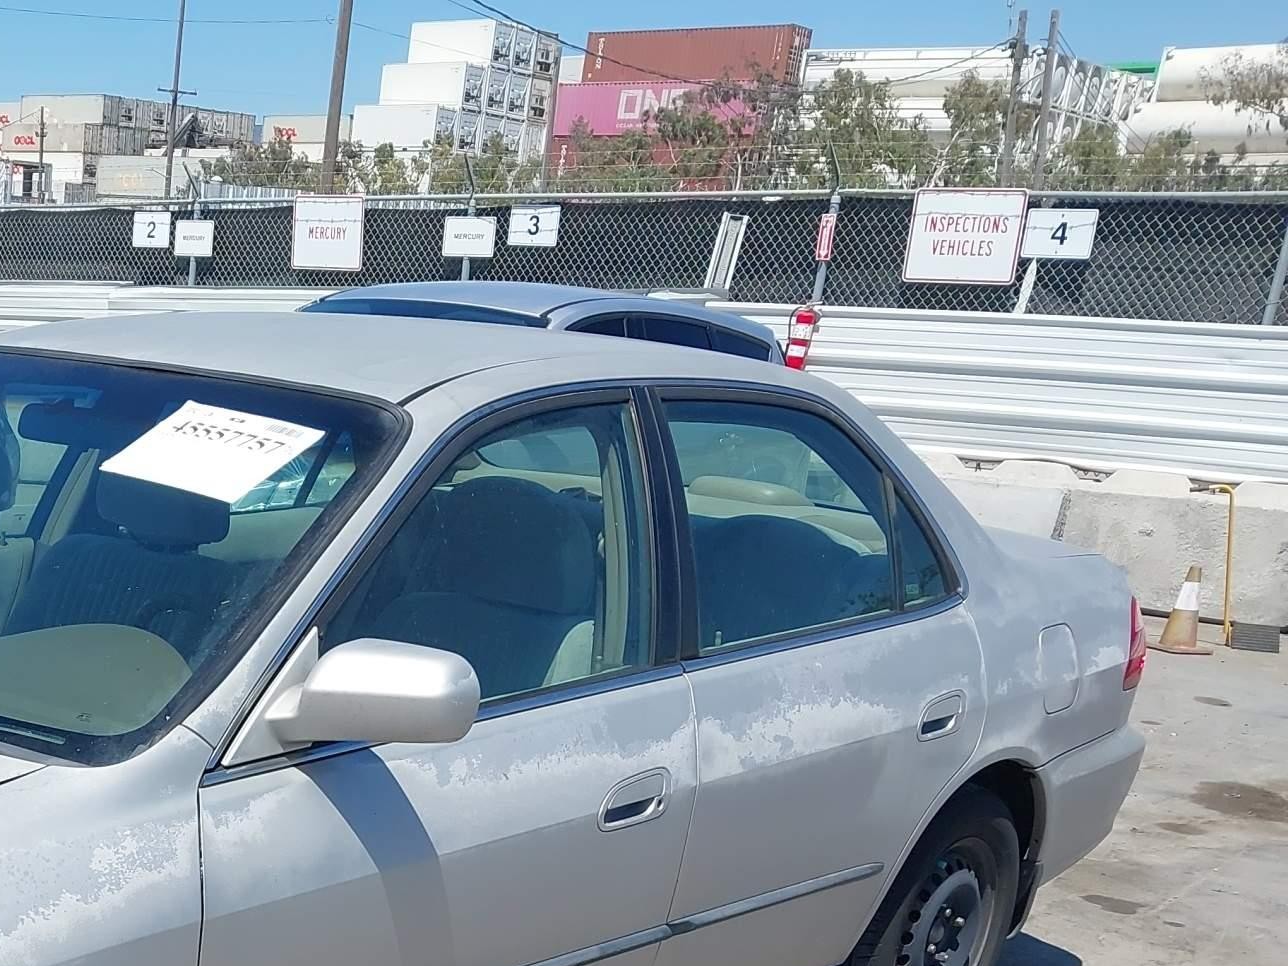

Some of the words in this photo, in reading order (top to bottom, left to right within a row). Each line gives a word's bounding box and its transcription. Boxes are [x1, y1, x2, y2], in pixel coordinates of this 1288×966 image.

[146, 221, 157, 239] 2
[308, 226, 347, 241] MERCURY
[527, 215, 540, 236] 3
[924, 216, 1010, 234] INSPECTIONS
[1050, 221, 1068, 246] 4
[932, 239, 994, 257] VEHICLES
[172, 420, 286, 455] 45557757
